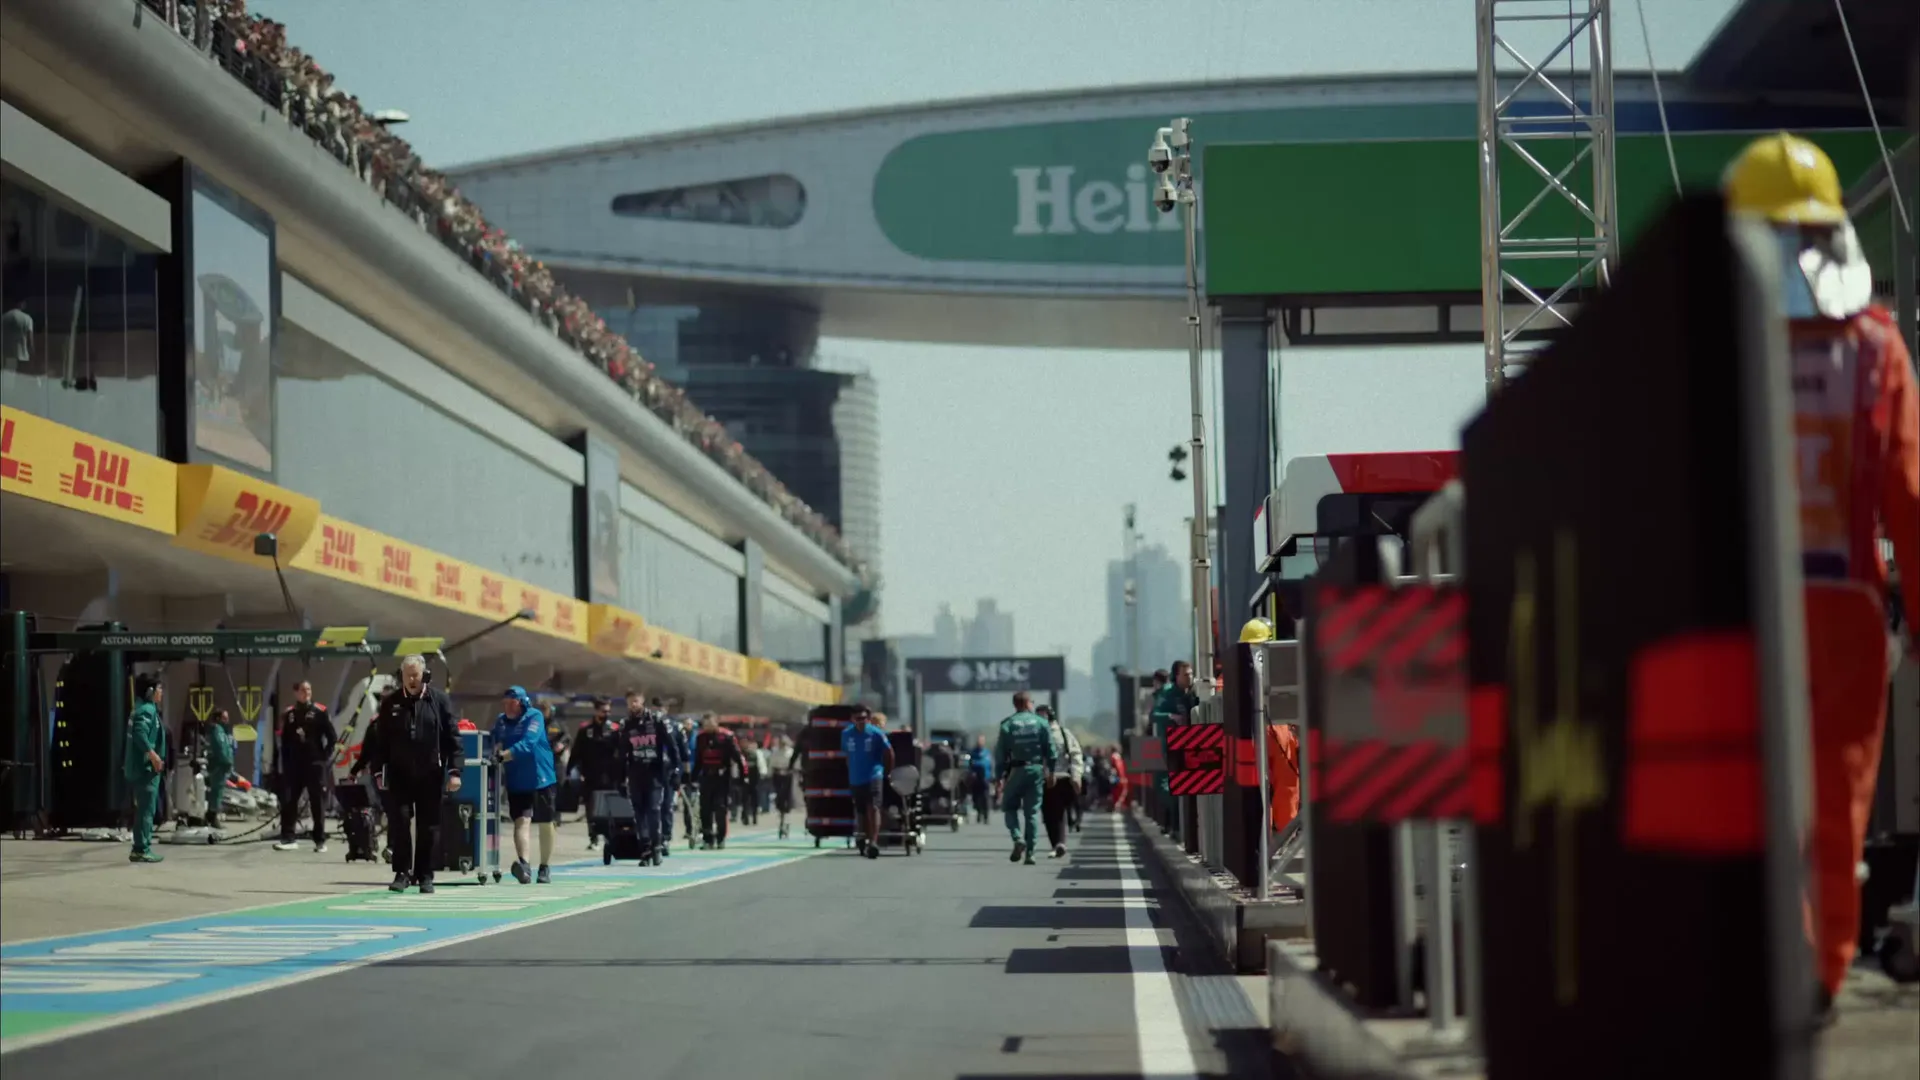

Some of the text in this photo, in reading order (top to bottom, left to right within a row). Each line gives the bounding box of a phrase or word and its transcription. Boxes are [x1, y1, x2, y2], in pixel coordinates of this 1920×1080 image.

[72, 441, 134, 512] DHL
[322, 525, 360, 574] DHL
[382, 545, 414, 590] DHL
[101, 635, 214, 645] ASTON MARTIN aramco
[276, 634, 302, 644] arm
[975, 660, 1030, 682] MSC
